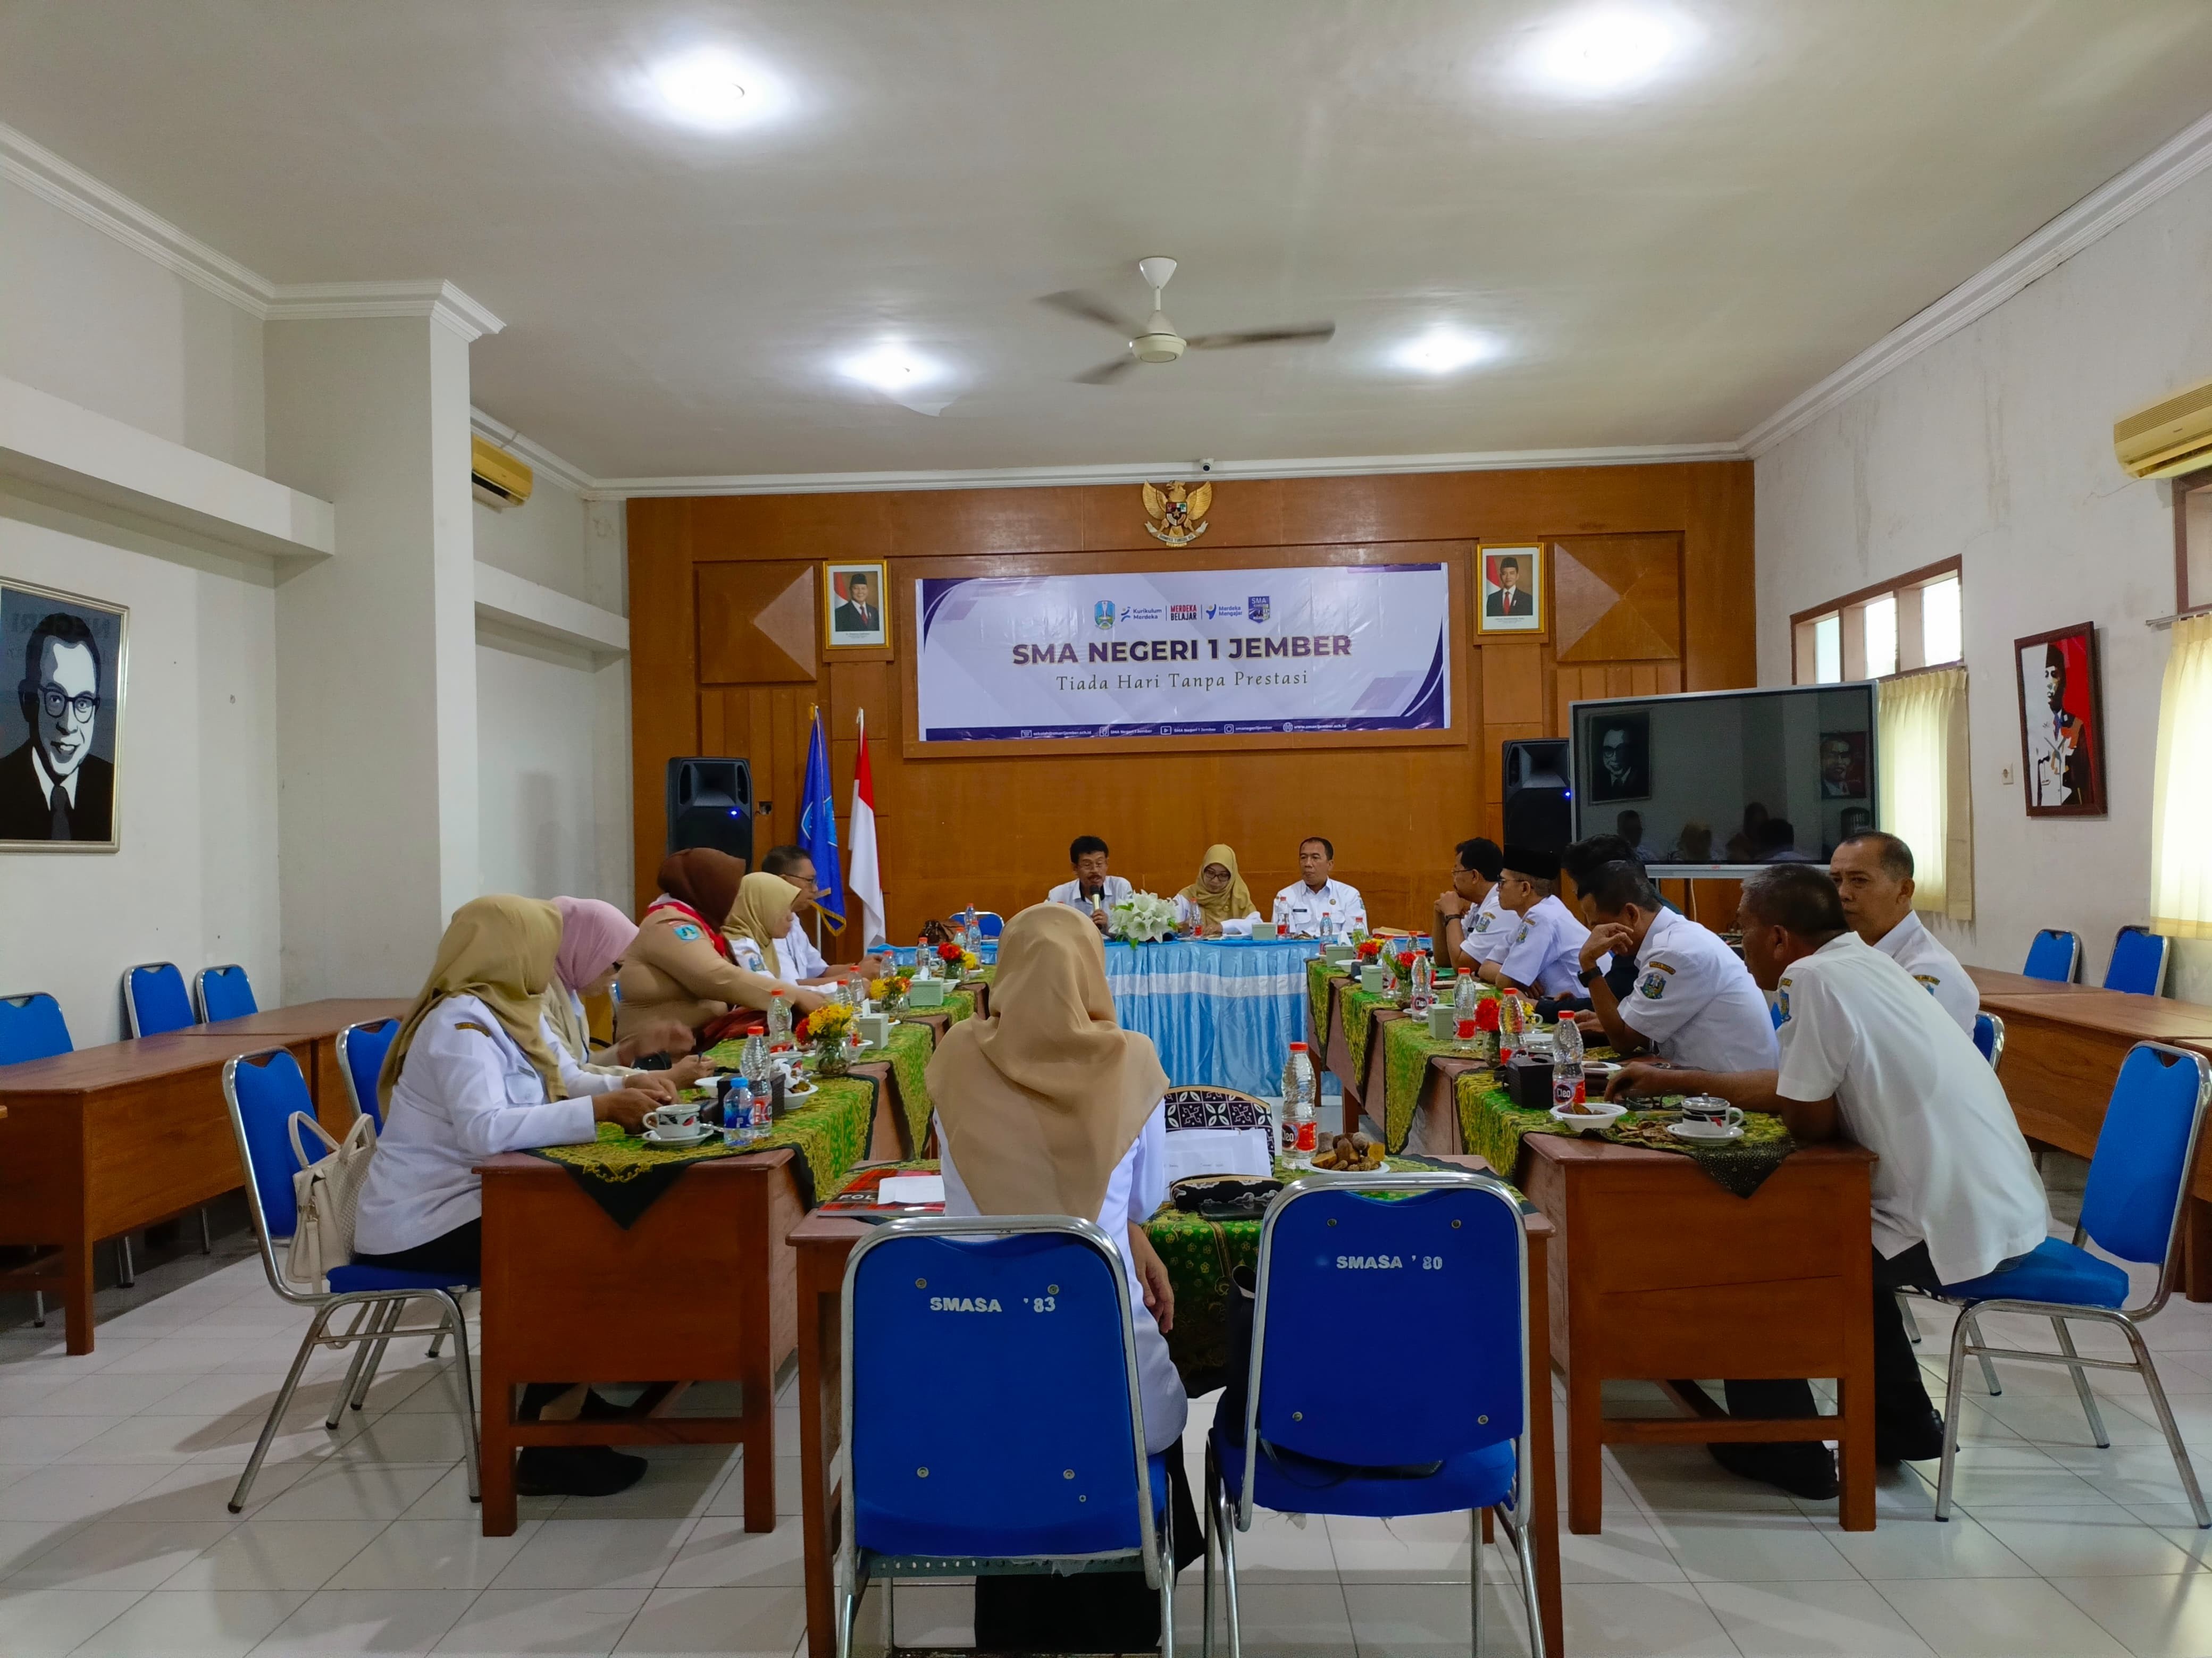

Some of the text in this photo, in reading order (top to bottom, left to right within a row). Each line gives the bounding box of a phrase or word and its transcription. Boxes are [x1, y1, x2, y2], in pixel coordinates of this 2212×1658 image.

[1171, 612, 1196, 621] BELAJAR
[1012, 635, 1352, 664] SMA NEGERI 1 JEMBER
[1056, 670, 1308, 692] Tiada Hari Tanpa Prestasi
[1557, 1088, 1571, 1098] Cleo
[1336, 1255, 1403, 1269] SMASA
[930, 1297, 1002, 1312] SMASA
